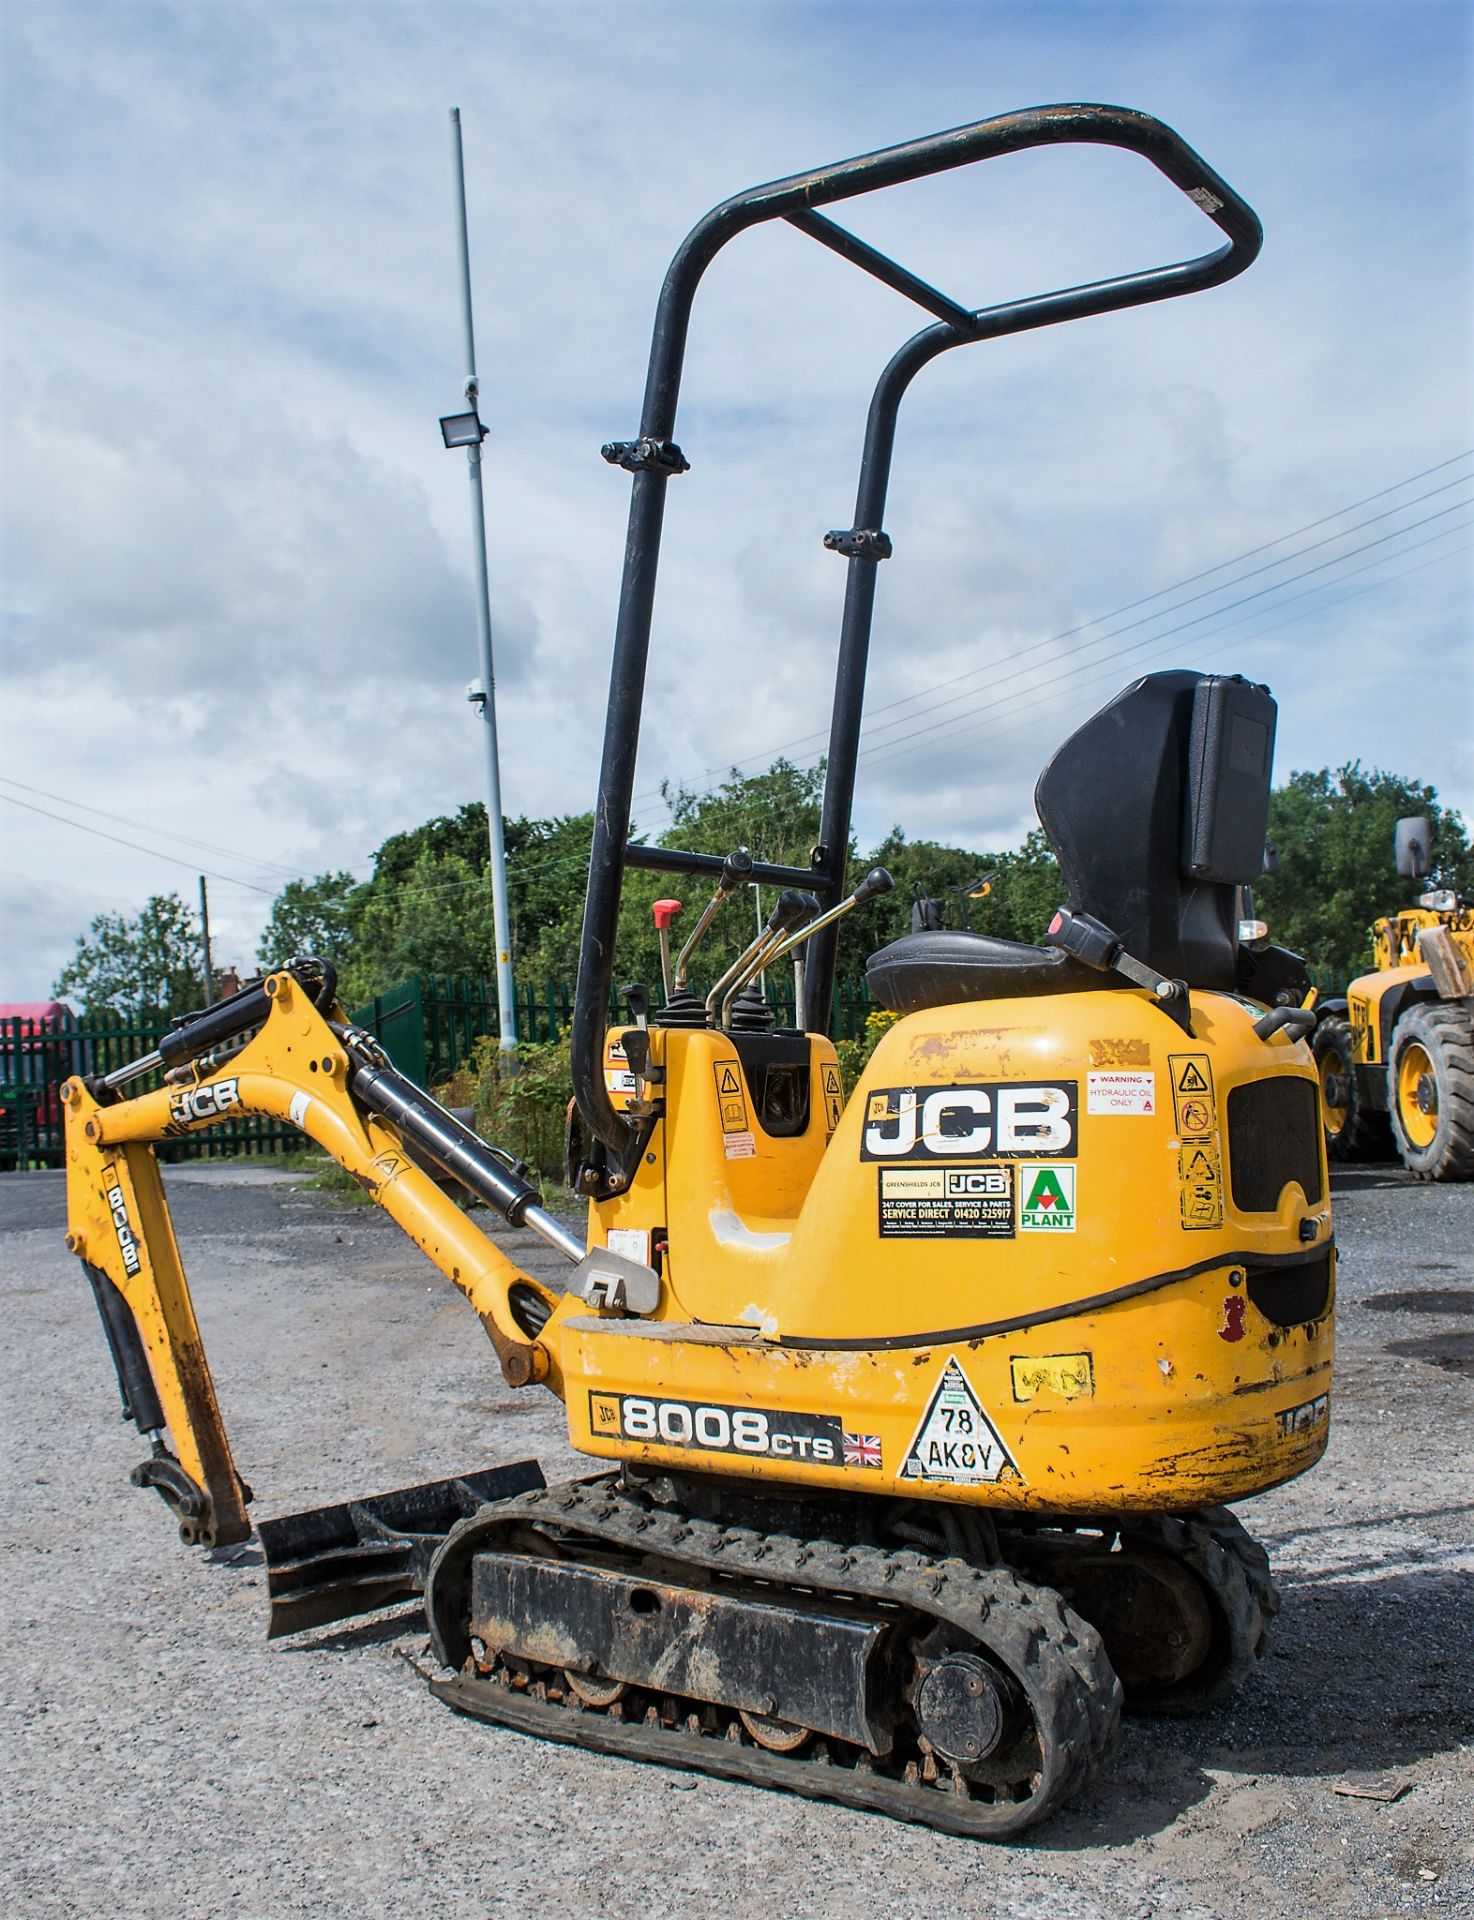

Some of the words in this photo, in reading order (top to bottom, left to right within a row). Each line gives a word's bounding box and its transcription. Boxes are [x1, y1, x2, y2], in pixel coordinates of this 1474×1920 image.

[172, 1079, 240, 1121] JCB
[1139, 1089, 1152, 1097] OIL
[865, 1087, 1072, 1156] JCB
[950, 1174, 1006, 1193] JCB
[1025, 1170, 1070, 1211] A
[932, 1201, 954, 1209] SALES,
[882, 1209, 916, 1219] SERVICE
[918, 1209, 950, 1219] DIRECT
[954, 1209, 979, 1218] 01420
[981, 1209, 1011, 1219] 525917
[1021, 1214, 1074, 1226] PLANT
[599, 1406, 616, 1422] JCB
[941, 1408, 973, 1434] 78
